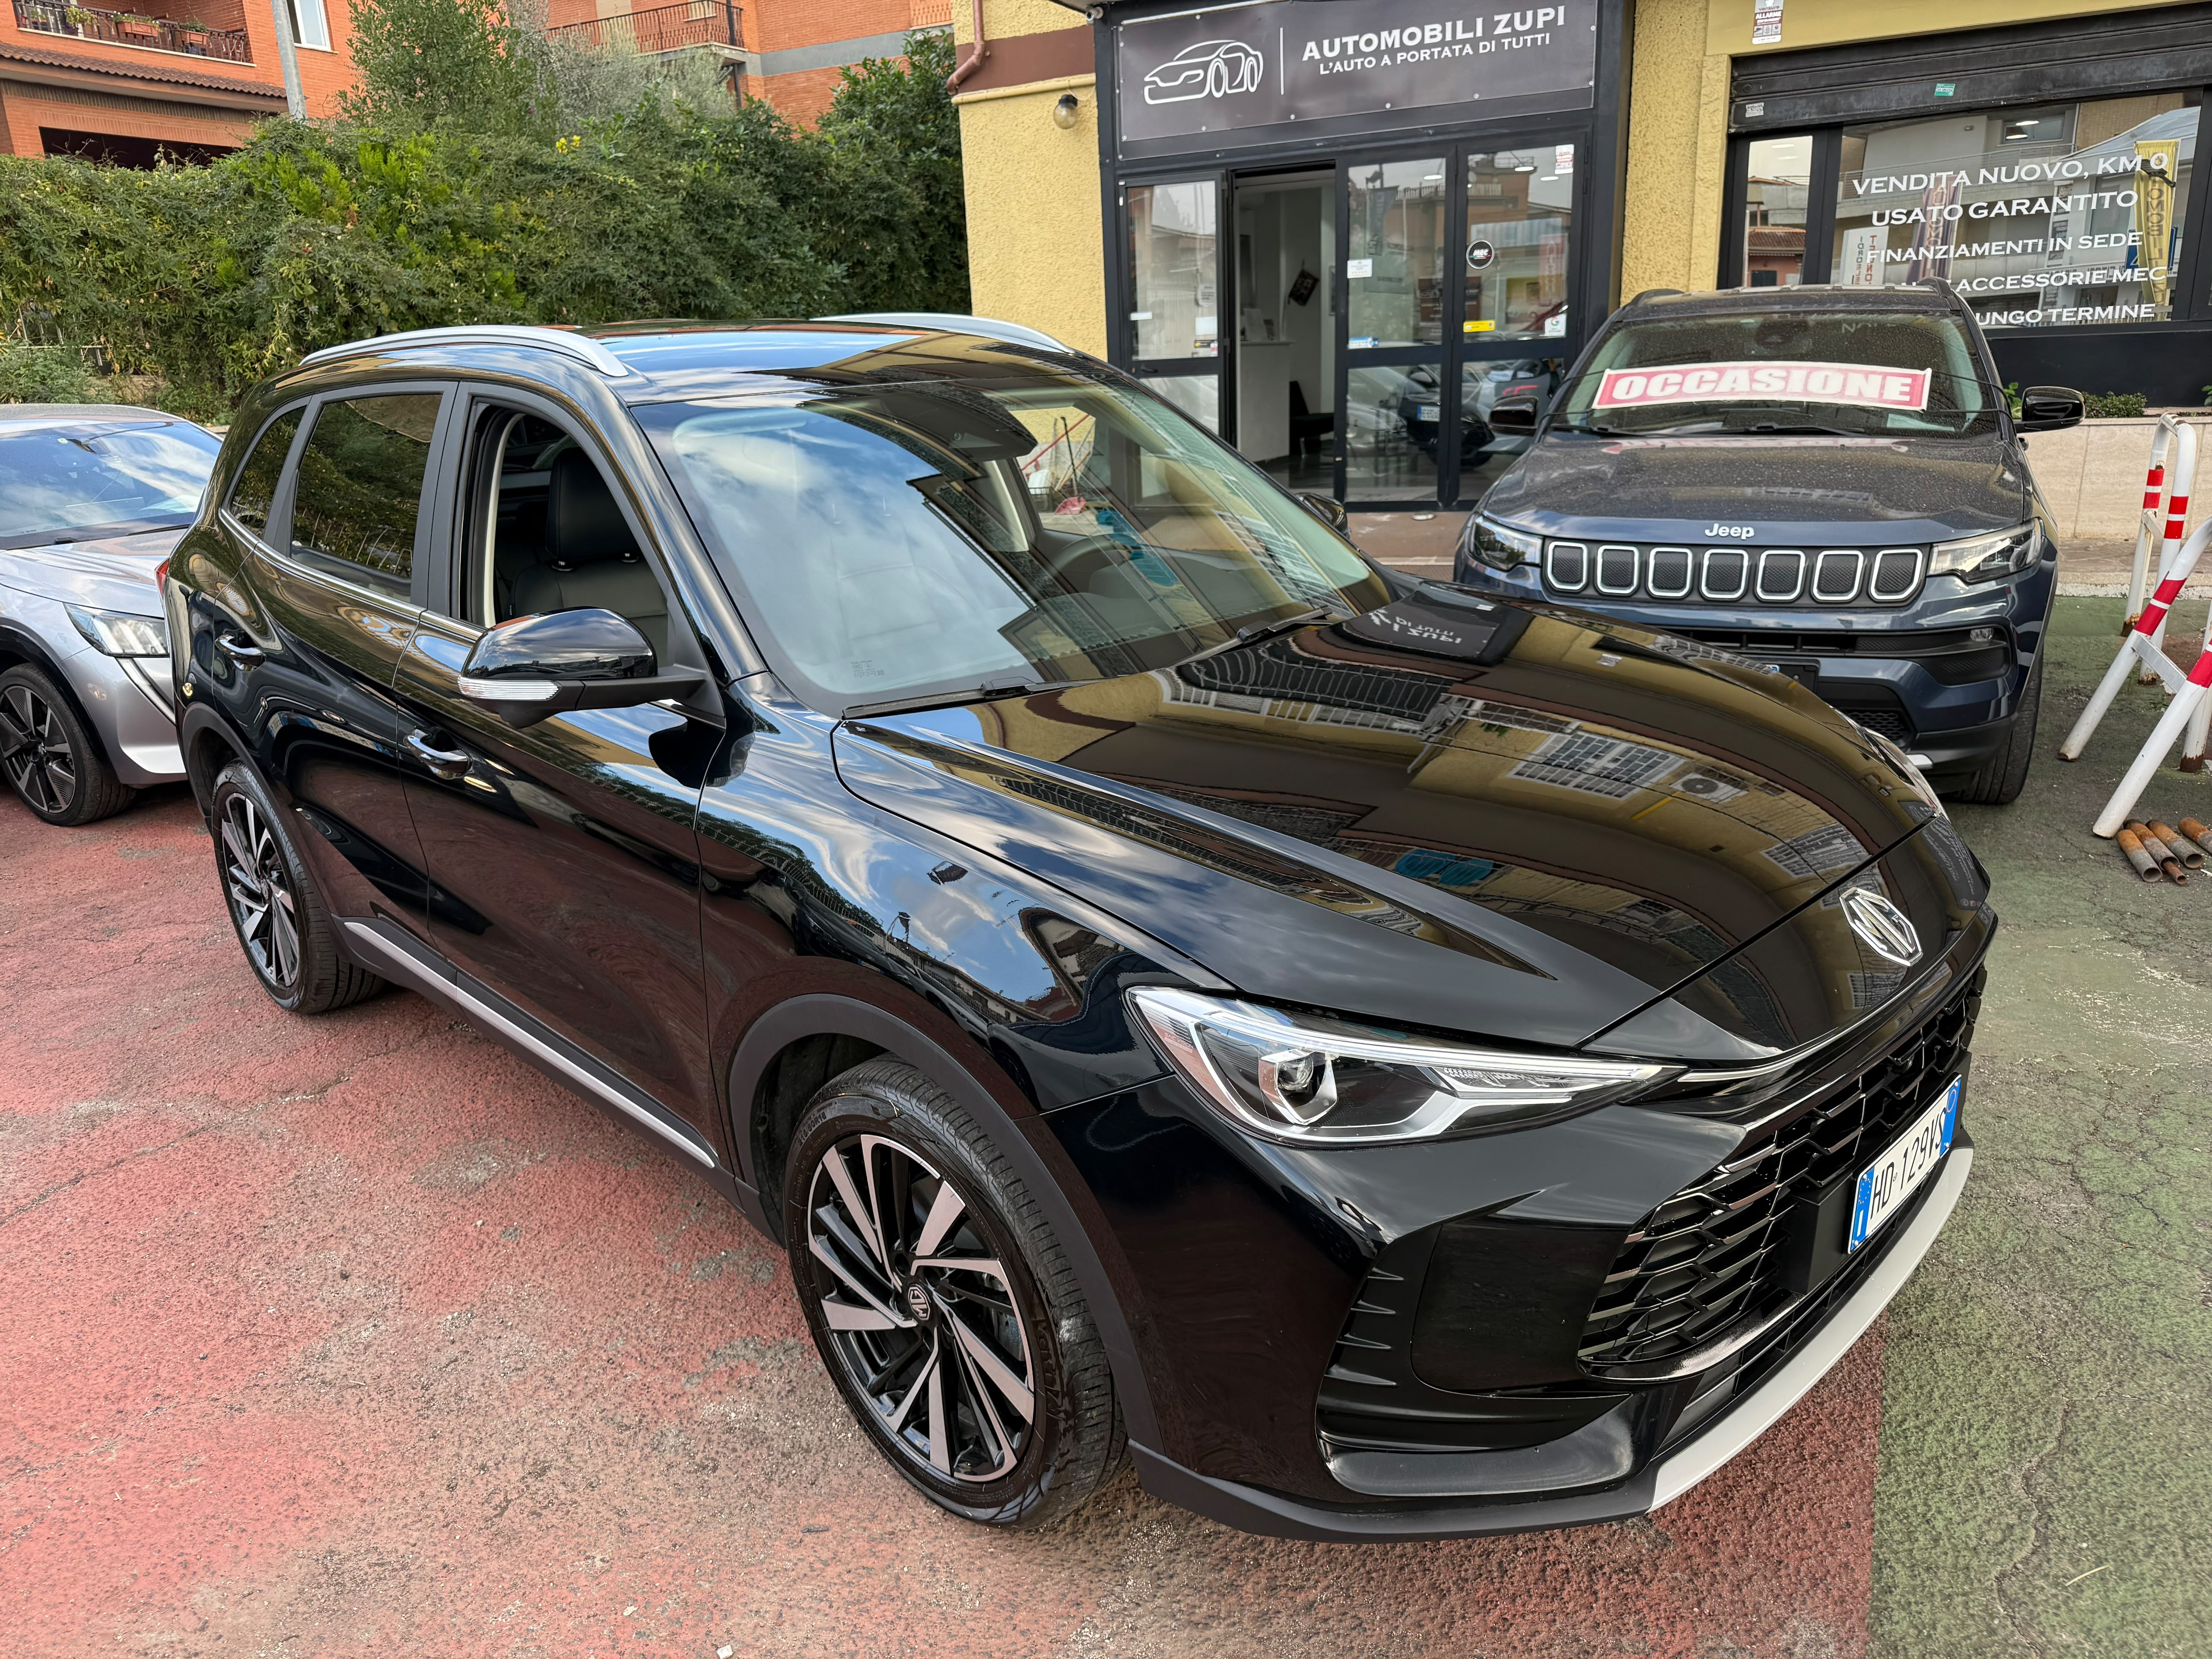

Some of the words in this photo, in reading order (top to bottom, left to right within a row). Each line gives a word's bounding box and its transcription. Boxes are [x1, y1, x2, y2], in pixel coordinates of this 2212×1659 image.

[1755, 11, 1782, 19] ALLARME
[1302, 17, 1484, 61] AUTOMOBILI
[1493, 6, 1566, 35] ZUPI
[1319, 57, 1376, 75] L'AUTO
[1381, 55, 1392, 67] A
[1397, 44, 1473, 64] PORTATA
[1478, 40, 1496, 53] DI
[1501, 33, 1550, 50] TUTTI
[1852, 170, 1972, 195] VENDITA
[1978, 160, 2088, 184] NUOVO,
[2097, 155, 2143, 174] KM
[1872, 204, 1963, 226] USATO
[1968, 191, 2138, 219] GARANTITO
[1866, 238, 2043, 264] FINANZIAMENTI
[2049, 237, 2073, 251] IN
[2078, 232, 2143, 249] SEDE
[1955, 270, 2108, 292] ACCESSORIE
[2112, 266, 2167, 283] MEC
[1975, 309, 2043, 325] UNGO
[2047, 304, 2156, 321] TERMINE
[1612, 368, 1912, 402] OCCASIONE
[1705, 523, 1754, 540] Jeep
[1870, 1161, 1895, 1220] HD
[1900, 1107, 1946, 1192] 129VS
